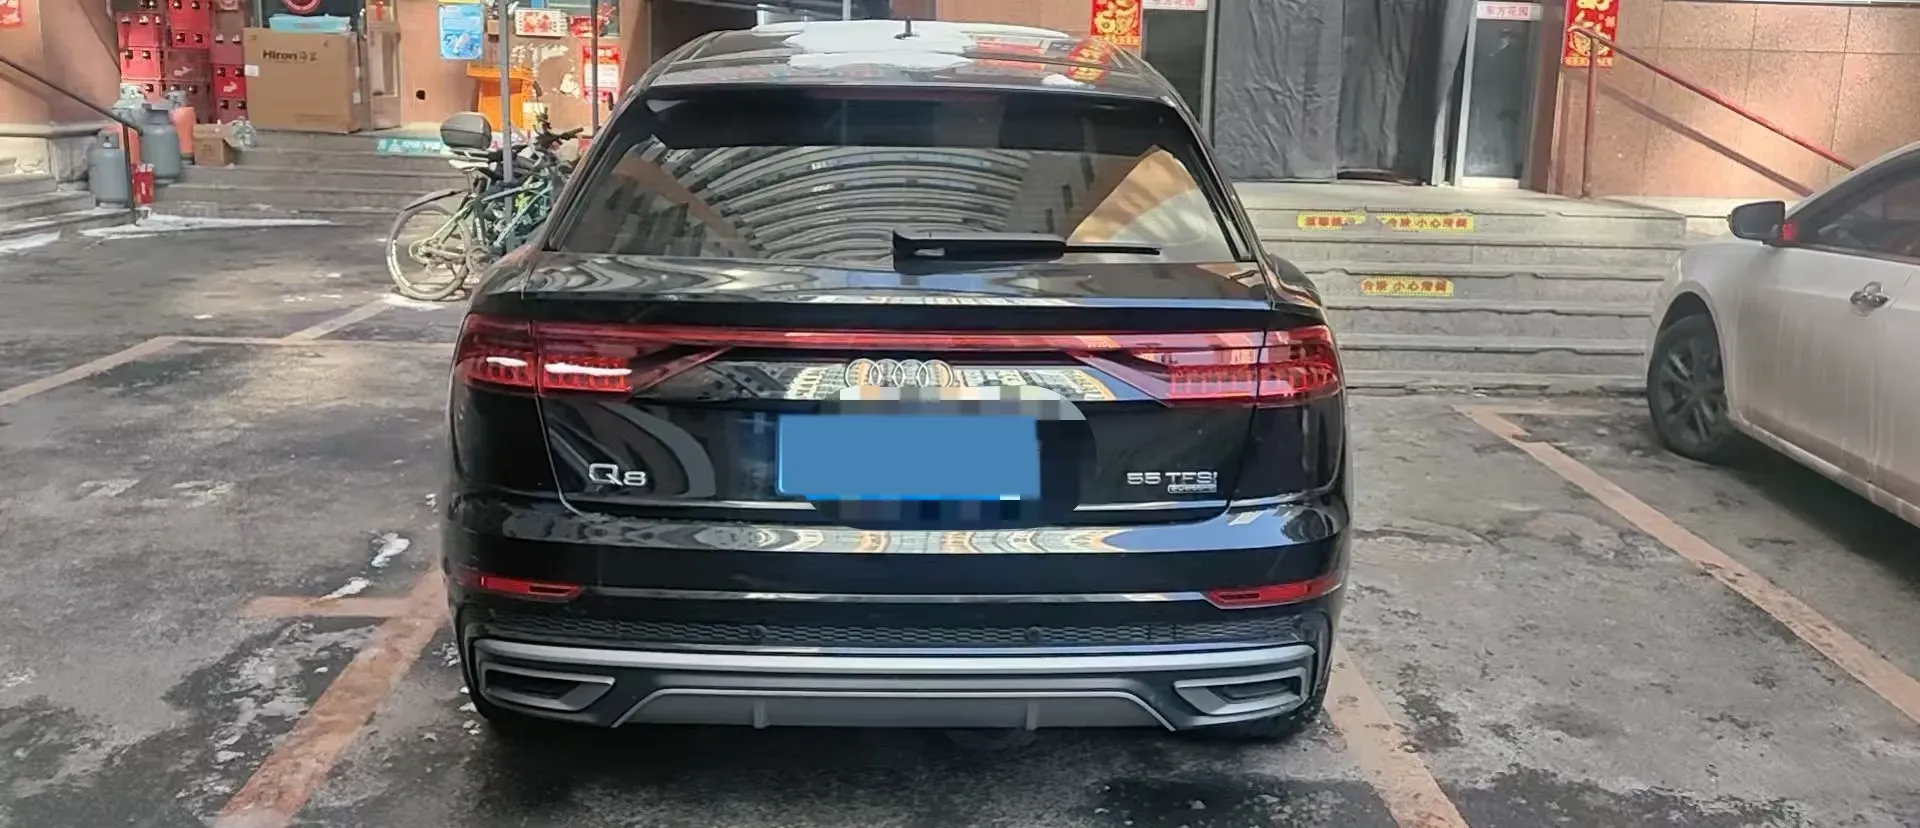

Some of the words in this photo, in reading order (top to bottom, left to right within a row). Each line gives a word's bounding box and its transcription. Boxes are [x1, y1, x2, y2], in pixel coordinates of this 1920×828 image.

[262, 50, 298, 60] Hiron
[588, 462, 647, 486] Q8
[1126, 472, 1162, 485] 55
[1164, 471, 1218, 486] TFSI
